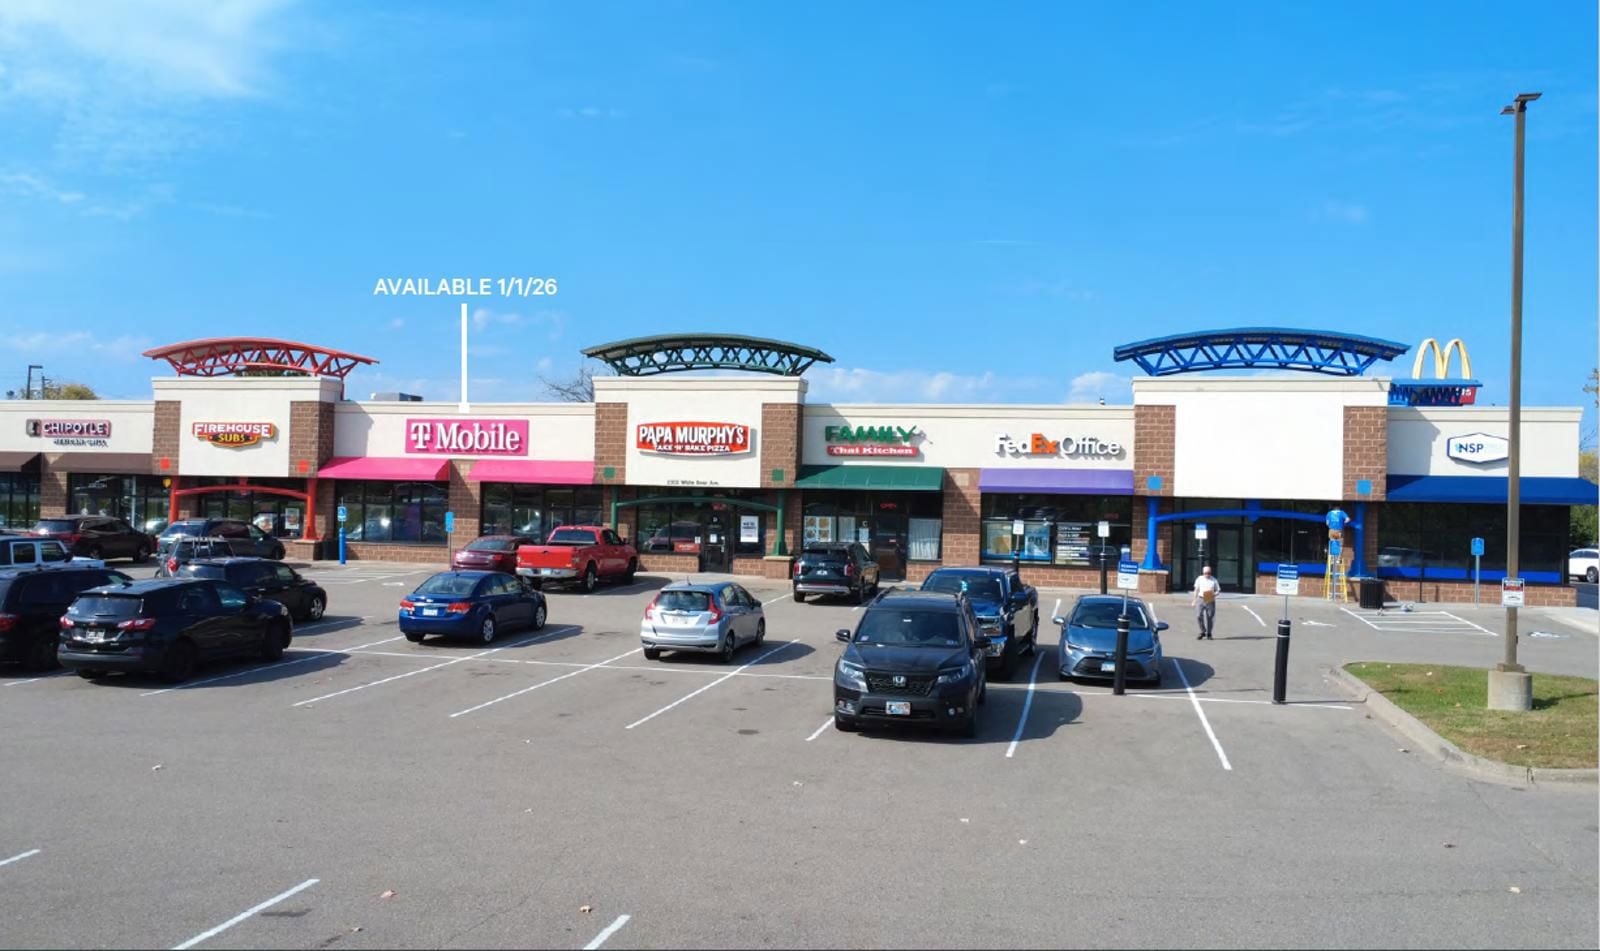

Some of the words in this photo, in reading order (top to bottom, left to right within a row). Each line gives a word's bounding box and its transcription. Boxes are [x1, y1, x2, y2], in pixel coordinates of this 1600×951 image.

[43, 422, 106, 434] CHIPOTLE
[193, 423, 272, 437] FIREHOUSE
[435, 422, 520, 450] Mobile
[639, 426, 674, 446] PAPA
[675, 425, 744, 446] MURPHY'S
[825, 425, 917, 443] FAMILY
[218, 433, 246, 442] SUBS
[995, 433, 1058, 454] FedEx
[1061, 435, 1121, 455] Office
[863, 447, 913, 455] Kitchen
